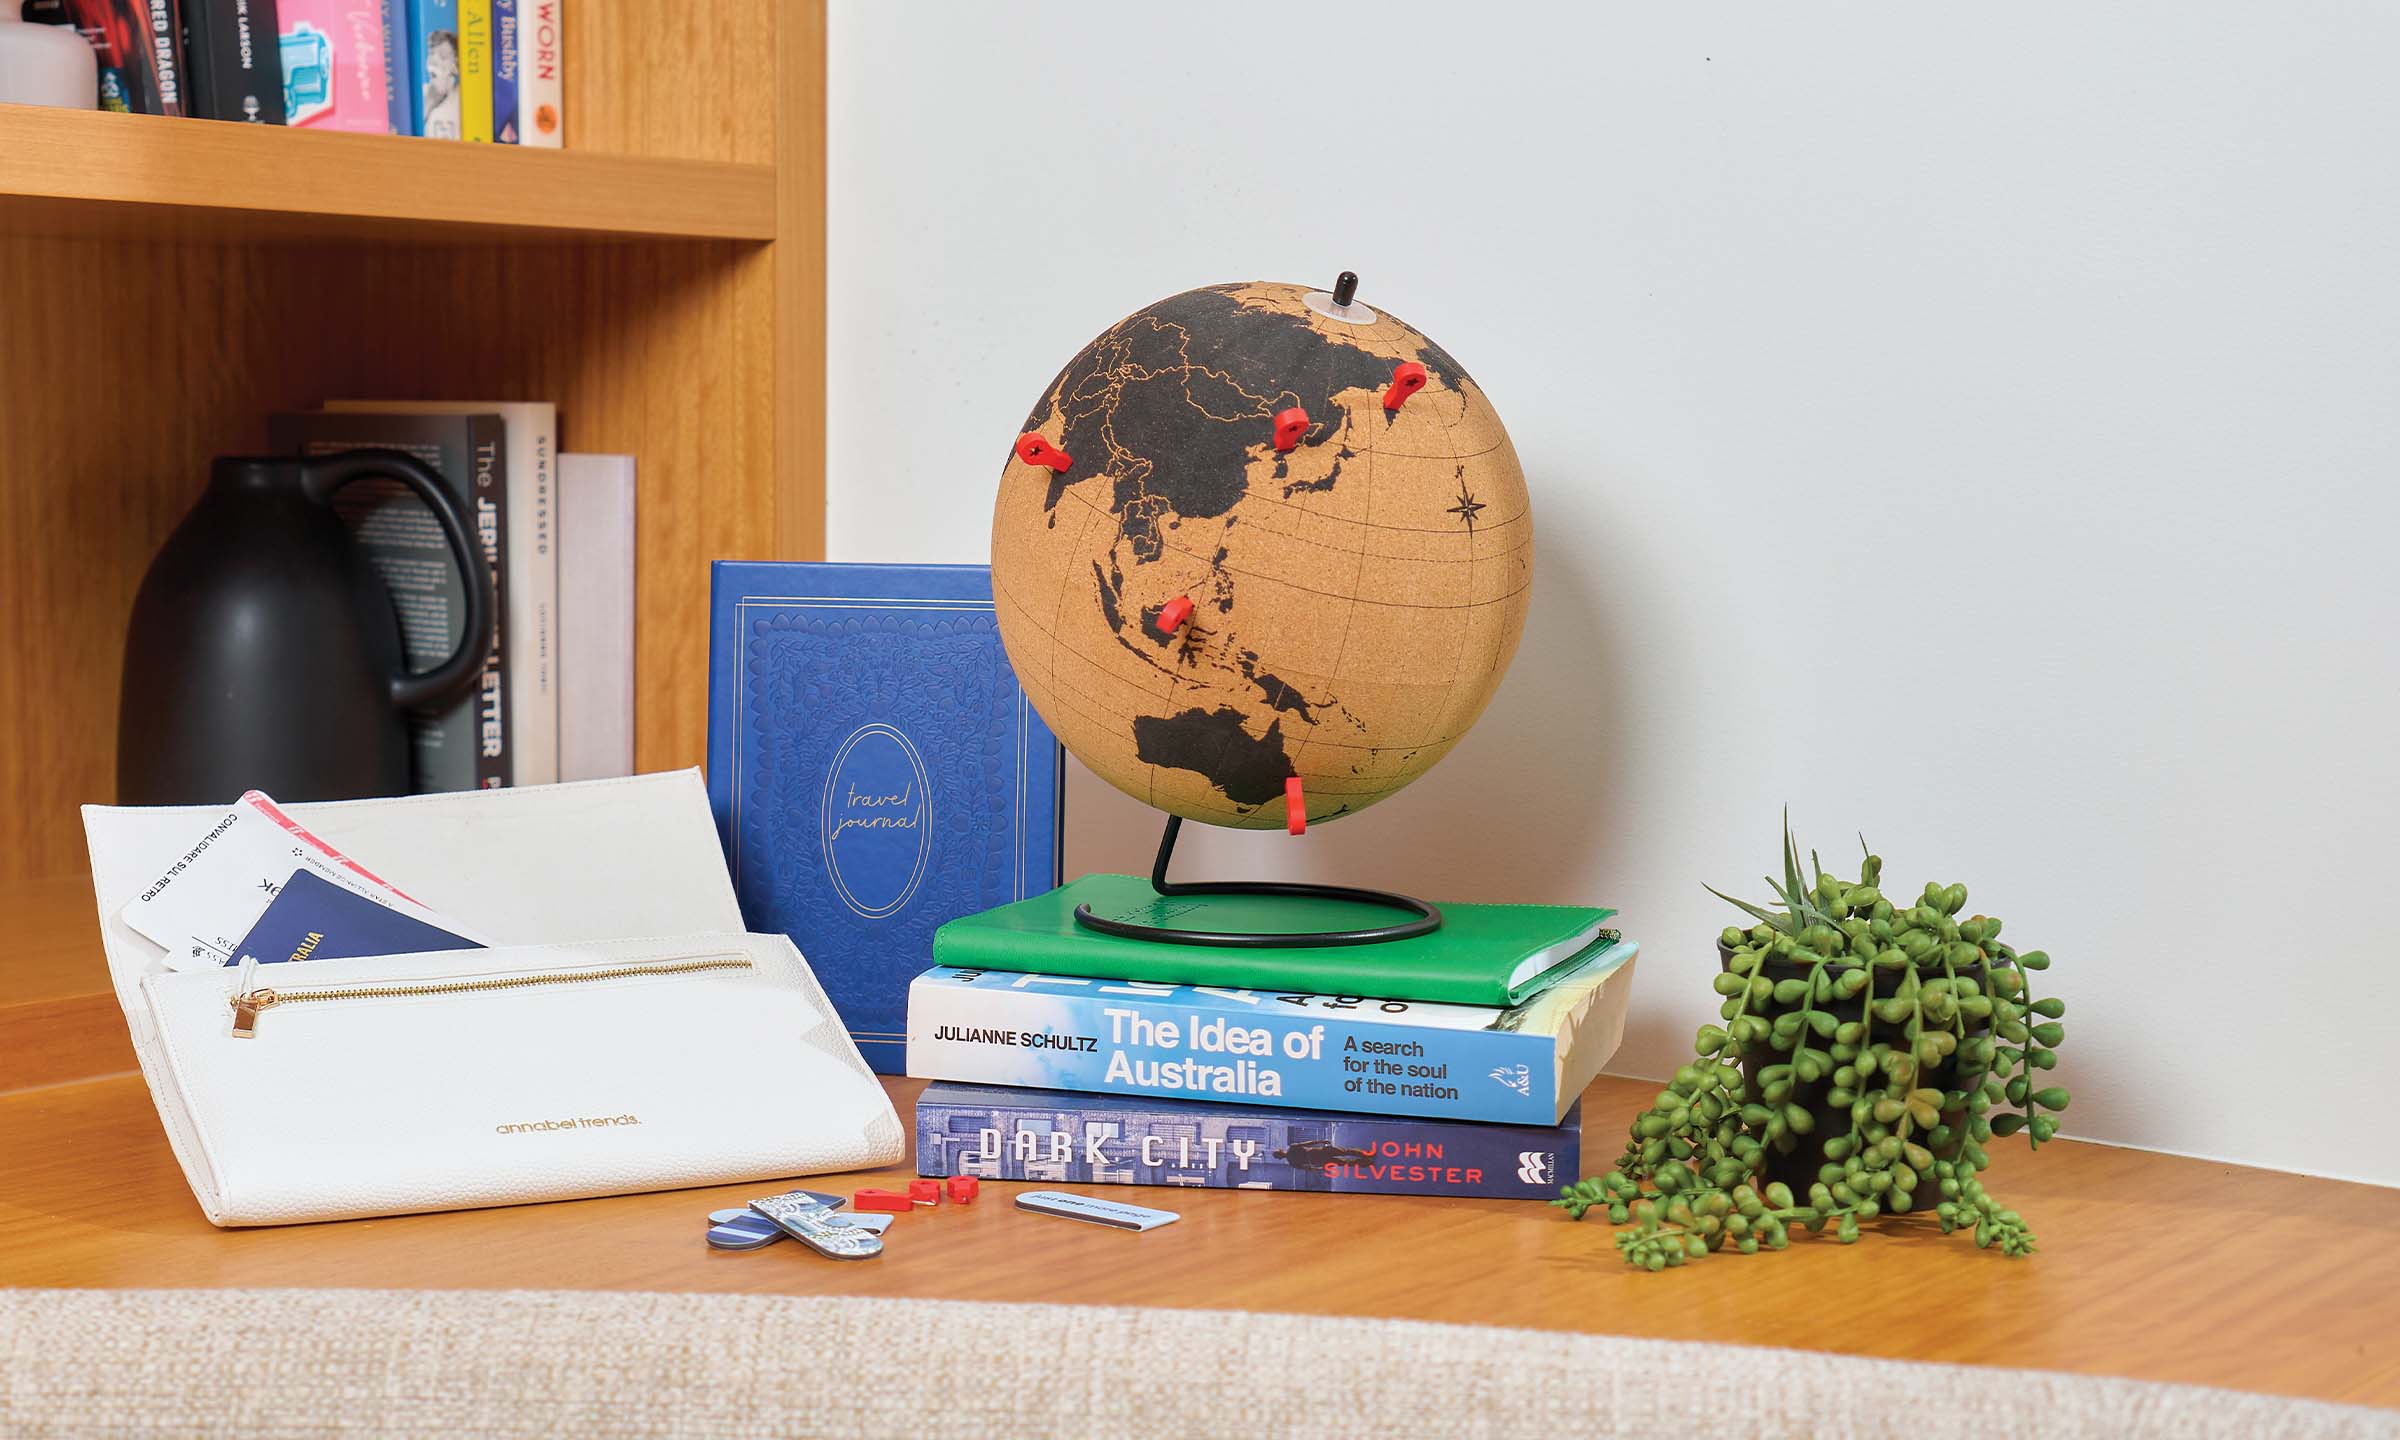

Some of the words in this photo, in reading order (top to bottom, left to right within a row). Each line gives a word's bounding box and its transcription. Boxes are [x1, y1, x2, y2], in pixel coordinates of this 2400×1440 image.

[150, 0, 168, 32] RED
[238, 16, 253, 69] LARSON
[466, 10, 485, 75] Allen
[537, 3, 555, 80] WORN
[155, 37, 178, 104] DRAGON
[477, 440, 497, 488] The
[536, 436, 548, 556] SUNDRESSED
[847, 781, 912, 808] travel
[183, 813, 238, 863] CONVALIDARE
[831, 803, 922, 841] journal
[166, 861, 187, 878] SUL
[141, 875, 171, 902] RETRO
[934, 1025, 1017, 1046] JULIANNE
[1020, 1032, 1098, 1052] SCHULTZ
[1103, 1008, 1180, 1048] The
[1190, 1015, 1272, 1056] Idea
[1283, 1025, 1325, 1060] of
[1343, 1036, 1358, 1053] A
[1361, 1039, 1424, 1057] search
[1103, 1050, 1282, 1097] Australia
[1343, 1056, 1370, 1073] for
[1373, 1058, 1404, 1076] the
[1407, 1064, 1447, 1080] soul
[1516, 1064, 1530, 1096] A&U
[1344, 1077, 1364, 1093] of
[1366, 1079, 1397, 1095] the
[1400, 1082, 1458, 1100] nation
[496, 1118, 577, 1134] annabel
[980, 1128, 1112, 1165] DARK
[1141, 1135, 1256, 1171] CITY
[1361, 1141, 1444, 1159] JOHN
[1323, 1161, 1483, 1184] SILVESTER
